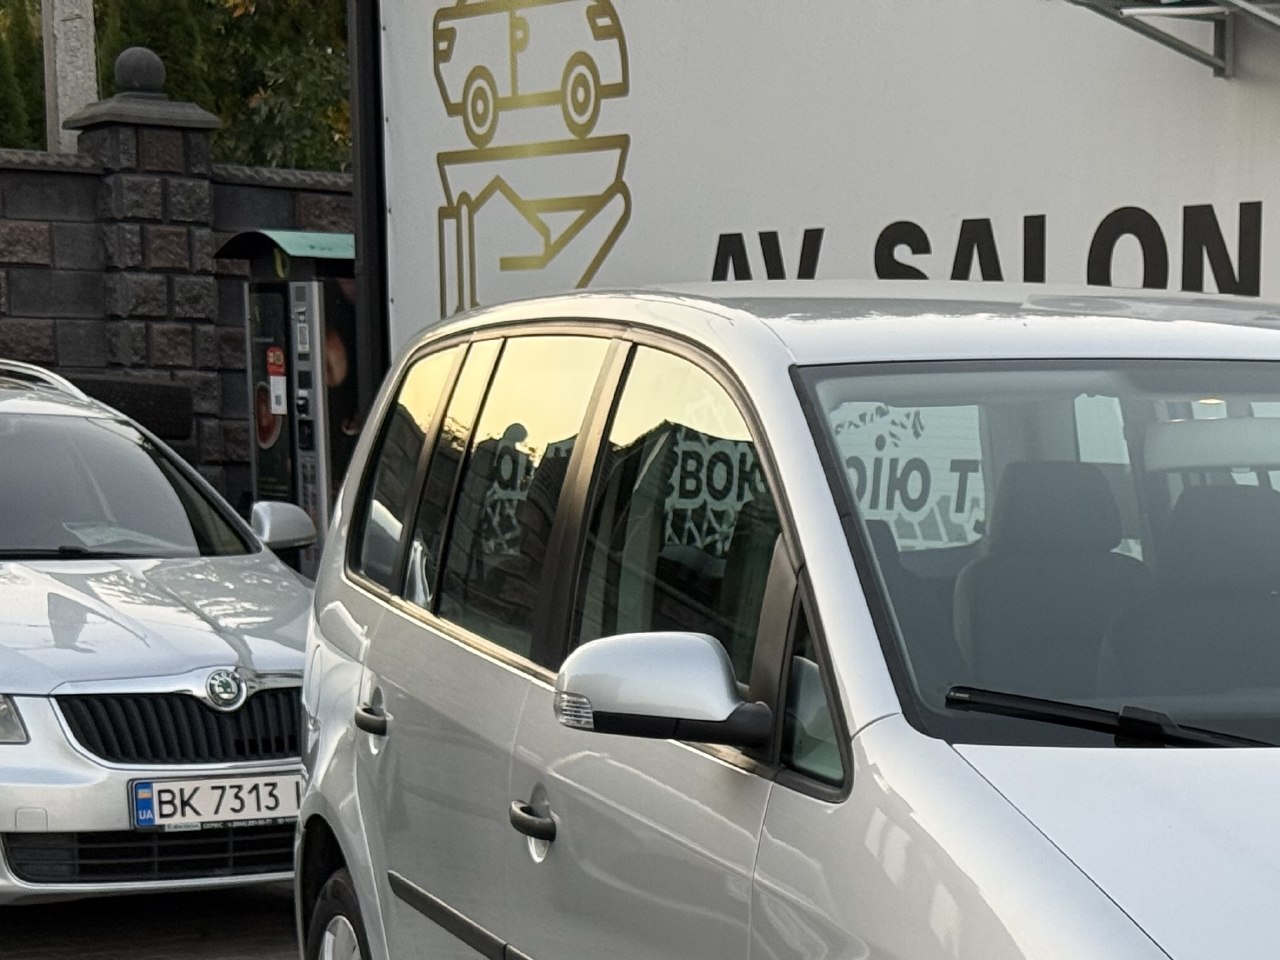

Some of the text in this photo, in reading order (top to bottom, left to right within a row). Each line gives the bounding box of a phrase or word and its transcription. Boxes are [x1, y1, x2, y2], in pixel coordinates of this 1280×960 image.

[157, 786, 202, 819] BK
[211, 782, 280, 816] 7313
[138, 810, 154, 821] UA
